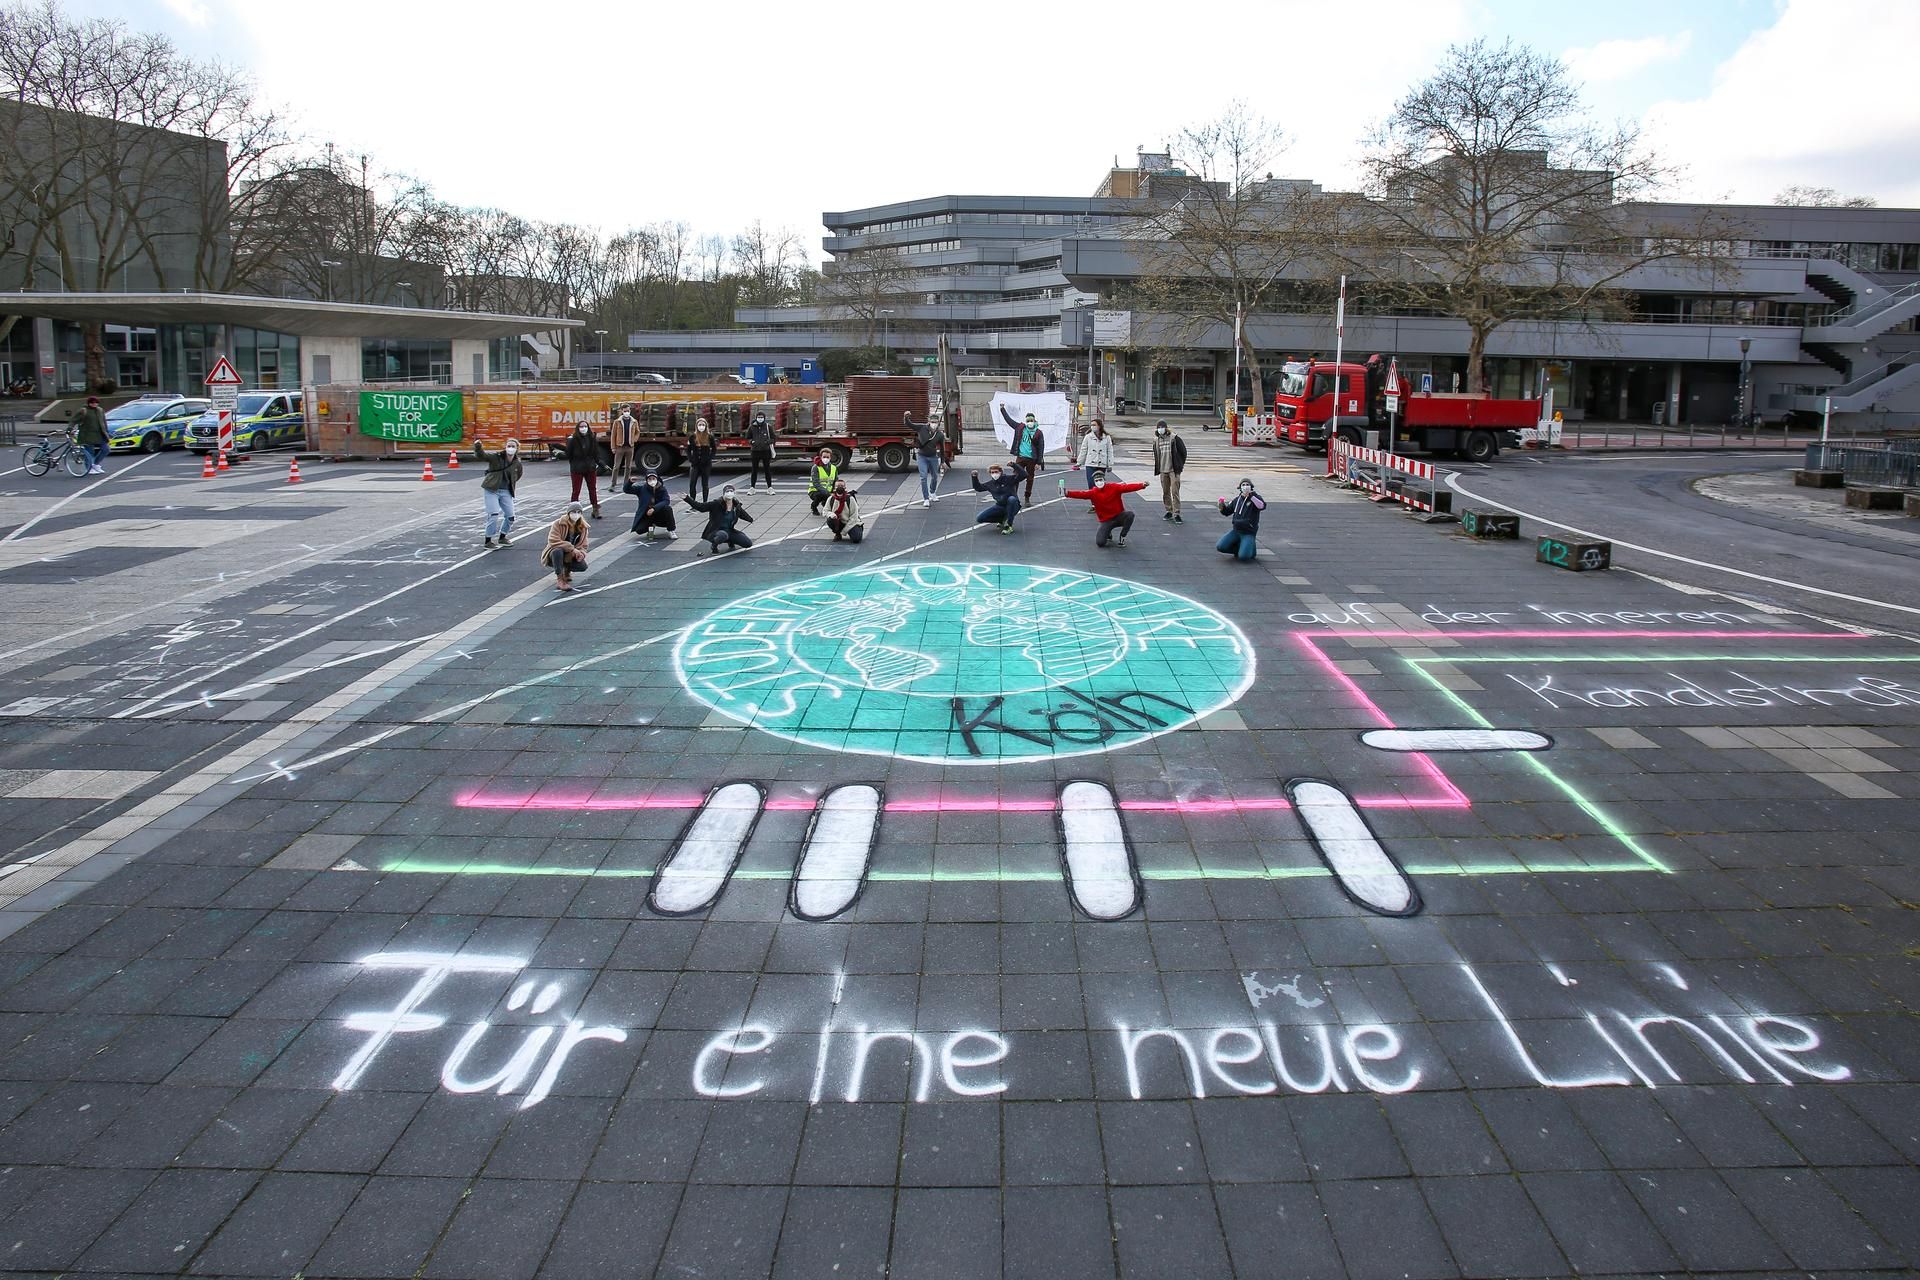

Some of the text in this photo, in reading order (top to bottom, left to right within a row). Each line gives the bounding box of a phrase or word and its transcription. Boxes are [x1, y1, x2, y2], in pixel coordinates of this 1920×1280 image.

[373, 393, 448, 411] STUDENTS
[399, 411, 422, 422] FOR
[551, 410, 612, 424] DANKE!
[382, 422, 439, 438] FUTURE
[1540, 539, 1569, 567] 12
[1287, 602, 1754, 625] auf der inneren
[686, 563, 1242, 718] STUDENTS FOR FUTURE
[950, 684, 1197, 758] Köln
[331, 951, 1853, 1109] Für eine neue Linie
